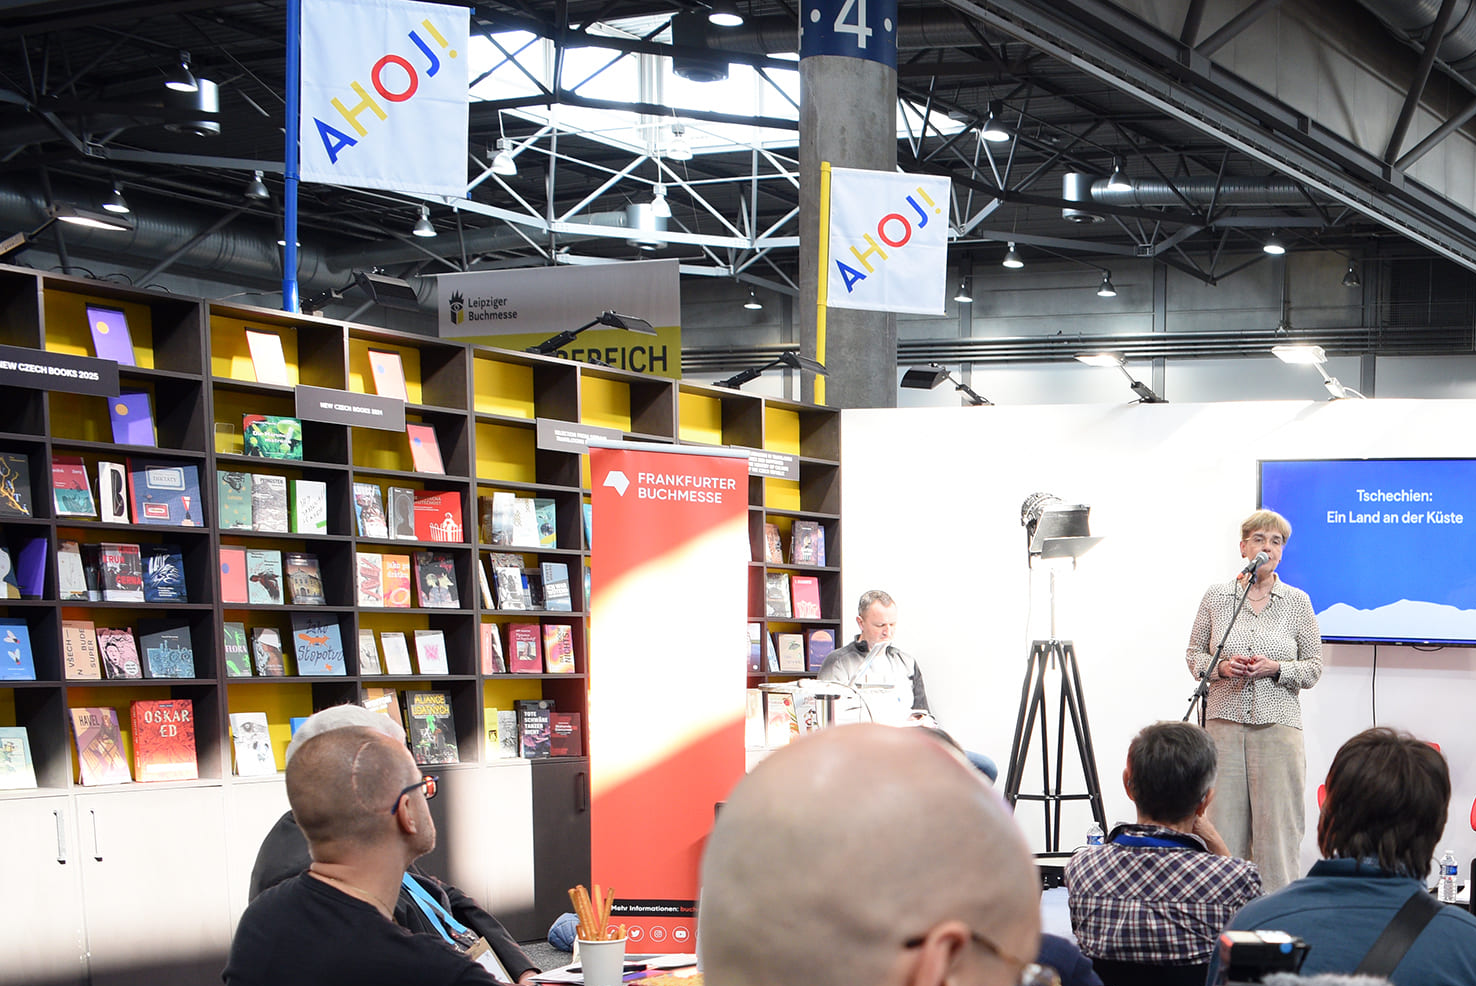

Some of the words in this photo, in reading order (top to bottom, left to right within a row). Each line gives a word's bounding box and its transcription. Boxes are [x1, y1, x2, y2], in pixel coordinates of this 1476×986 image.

[833, 0, 873, 48] 4
[313, 19, 458, 165] AHOJ!
[834, 186, 942, 293] AHOJ!
[468, 296, 508, 309] Leipziger
[468, 310, 518, 321] Buchmesse
[17, 362, 48, 374] CZECH
[48, 366, 78, 378] BOOKS
[78, 370, 100, 381] 2025
[638, 472, 736, 490] FRANKFURTER
[638, 487, 722, 504] BUCHMESSE
[1356, 489, 1433, 503] Tschechien:
[1327, 511, 1346, 523] Ein
[1349, 511, 1380, 524] Land
[1383, 514, 1399, 524] an
[1401, 511, 1424, 524] der
[1426, 510, 1464, 524] Küste
[78, 714, 101, 727] HAVEL
[144, 709, 191, 724] OSKAR
[159, 724, 178, 738] ED
[629, 904, 679, 913] Informationen:
